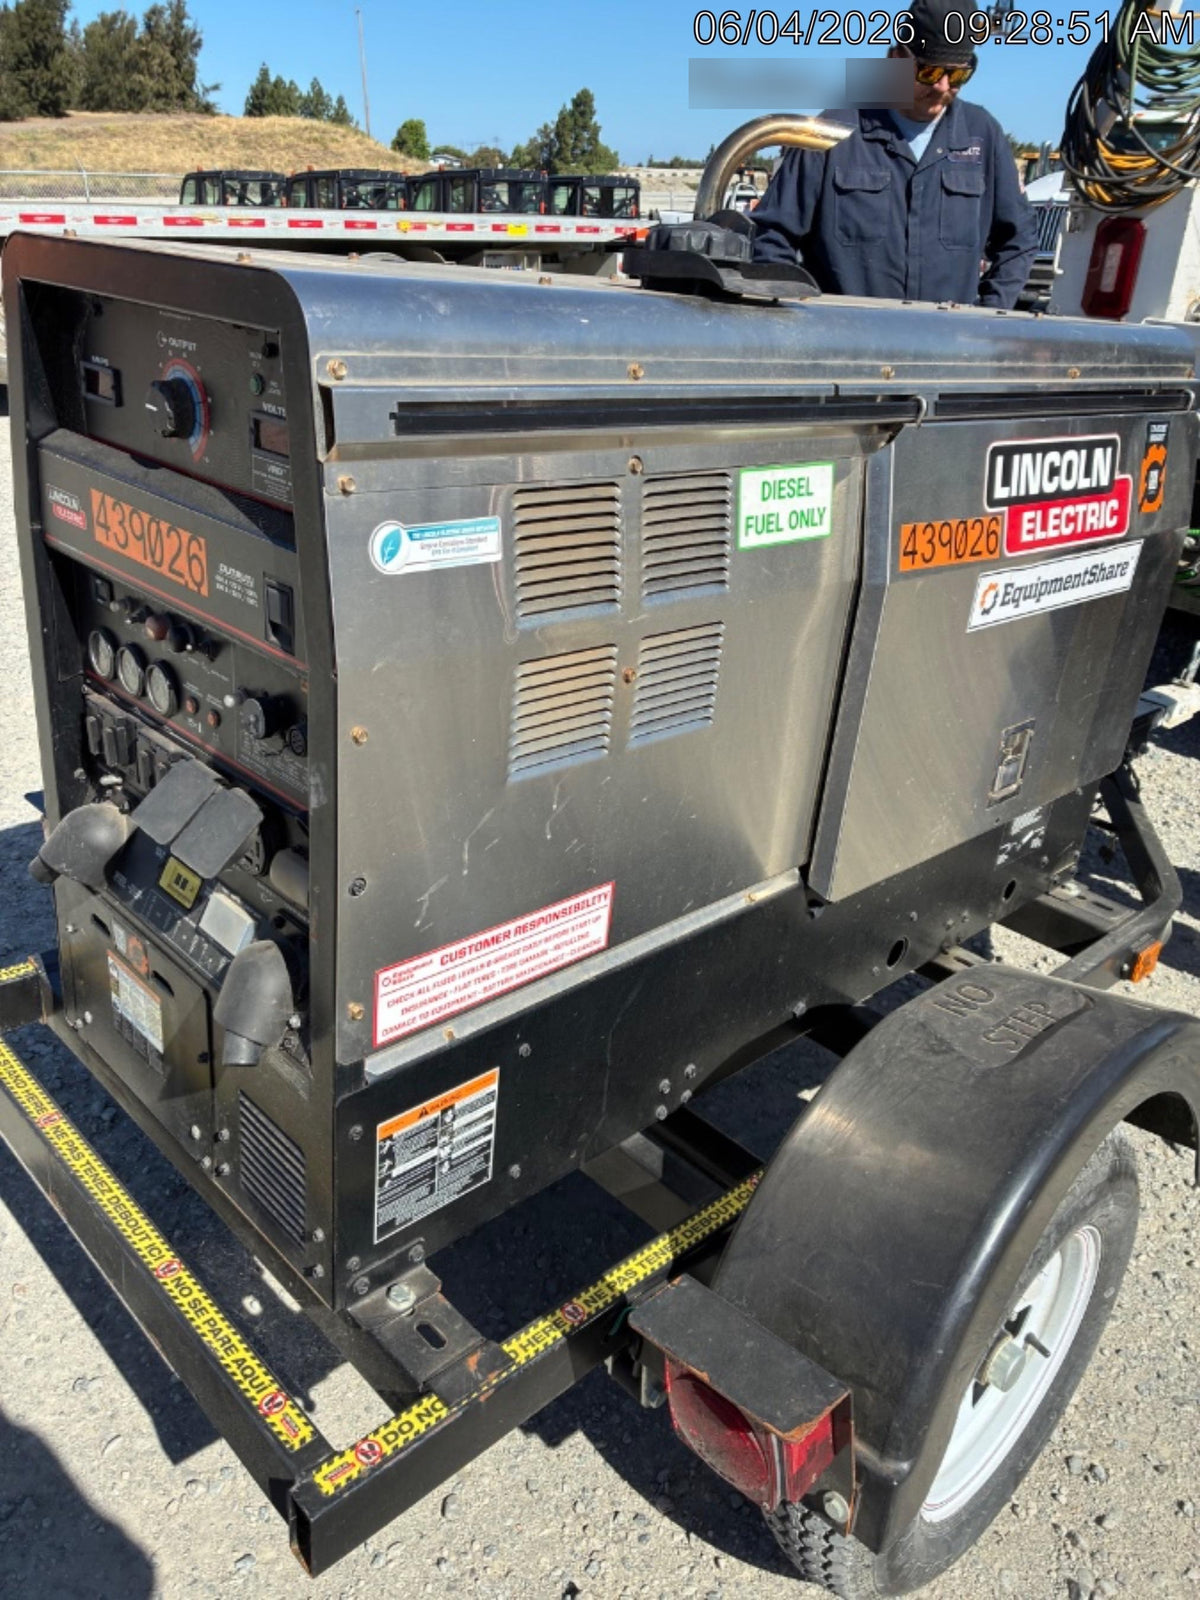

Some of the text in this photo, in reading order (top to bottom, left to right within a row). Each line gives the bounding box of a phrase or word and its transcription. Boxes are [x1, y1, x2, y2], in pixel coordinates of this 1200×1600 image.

[168, 336, 198, 352] OUTPUT
[761, 475, 815, 502] DIESEL
[993, 447, 1113, 499] LINCOLN
[95, 492, 206, 590] 439026
[744, 506, 827, 538] FUEL ONLY
[902, 516, 1001, 566] 439026
[1020, 499, 1119, 543] ELECTRIC
[1000, 559, 1130, 608] EquipmentShare
[440, 891, 609, 966] CUSTOMER RESPONSIBILITY
[387, 992, 415, 1008] CHECK
[933, 982, 995, 1018] NO
[982, 1000, 1057, 1054] STEP
[50, 1124, 166, 1262] NE PAS TENEZ DEBOUT ICI
[582, 1287, 610, 1309] NE
[608, 1267, 639, 1293] PAS
[638, 1236, 684, 1273] TENEZ
[682, 1199, 736, 1240] DEBOUT
[171, 1276, 194, 1299] NO
[187, 1297, 208, 1320] SE
[203, 1316, 240, 1357] PARE
[518, 1316, 566, 1354] HERE
[381, 1397, 445, 1446] DO NO
